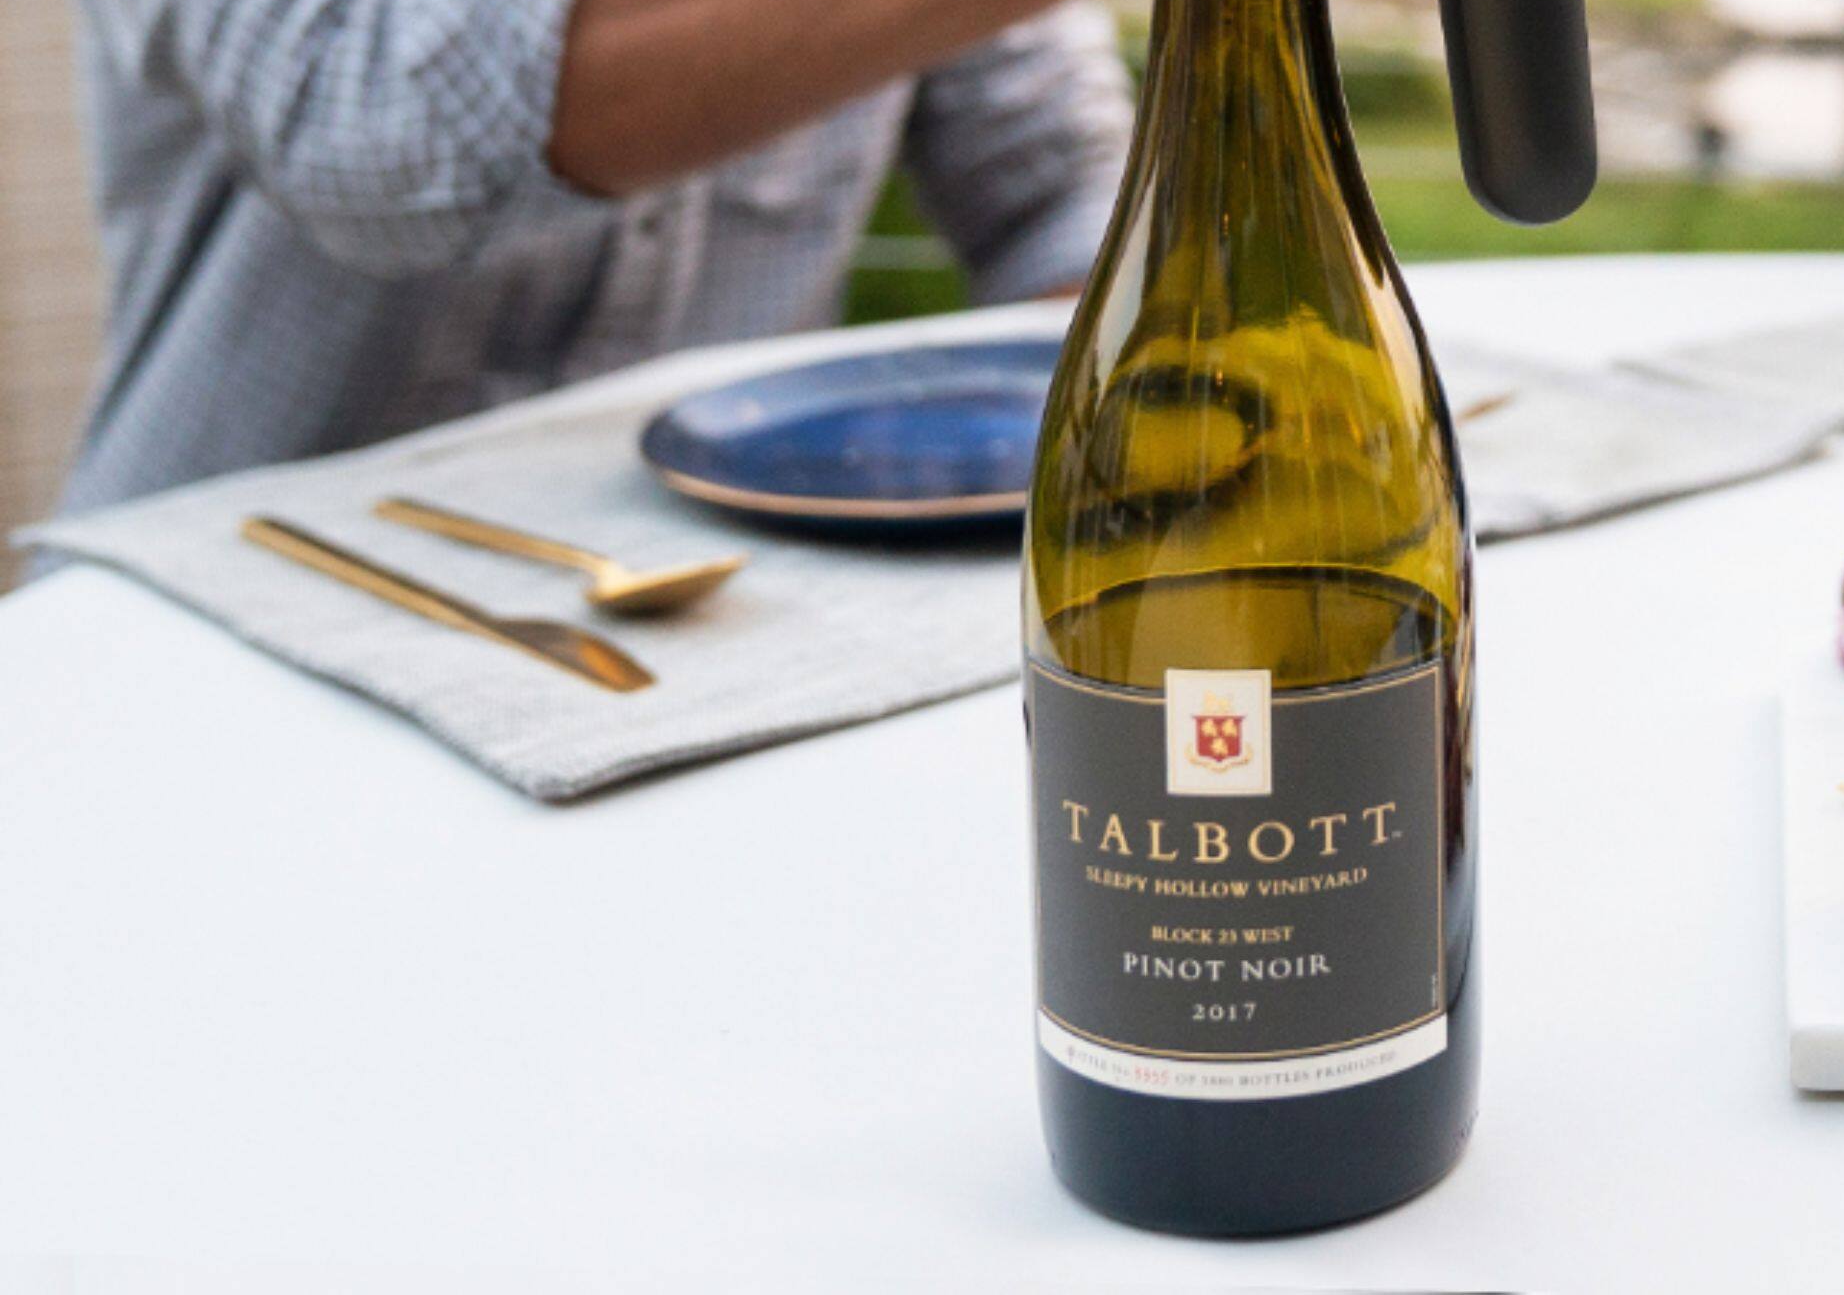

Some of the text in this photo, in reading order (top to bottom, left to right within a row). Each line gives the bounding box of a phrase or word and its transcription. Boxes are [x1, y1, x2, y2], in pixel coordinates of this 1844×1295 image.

[1062, 800, 1397, 863] TALBOTT
[1086, 865, 1368, 898] SLEEPY HOLLOW VINEYARD
[1151, 926, 1212, 944] BLOCK
[1243, 926, 1294, 944] WEST
[1124, 952, 1331, 982] PINOT NOIR
[1192, 1003, 1256, 1022] 2017
[1239, 1072, 1309, 1086] BOTTLES
